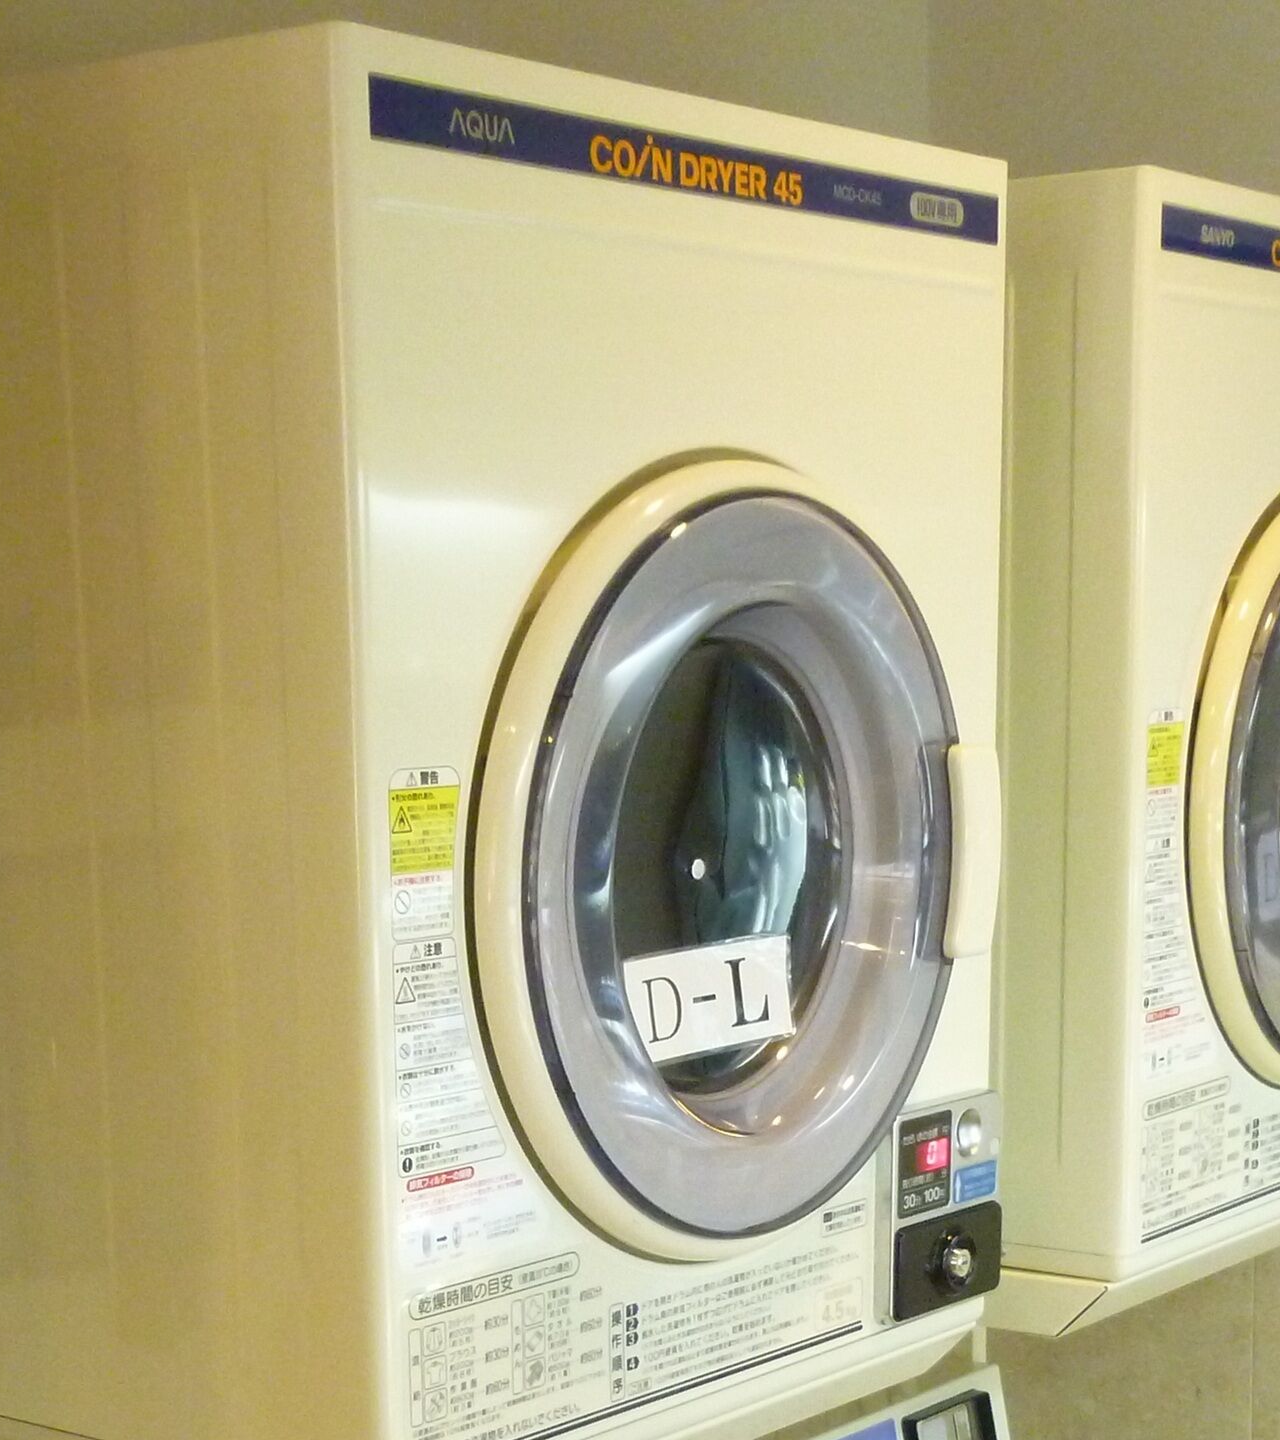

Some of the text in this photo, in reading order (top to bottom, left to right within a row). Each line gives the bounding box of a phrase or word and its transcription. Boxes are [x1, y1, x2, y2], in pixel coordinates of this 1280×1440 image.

[449, 107, 516, 146] AQUA
[589, 134, 803, 206] COIN DRYER 45
[1200, 224, 1236, 248] SANYO
[423, 942, 443, 957] 注意
[641, 957, 770, 1044] D-L
[417, 1273, 514, 1316] 乾燥時間の目安
